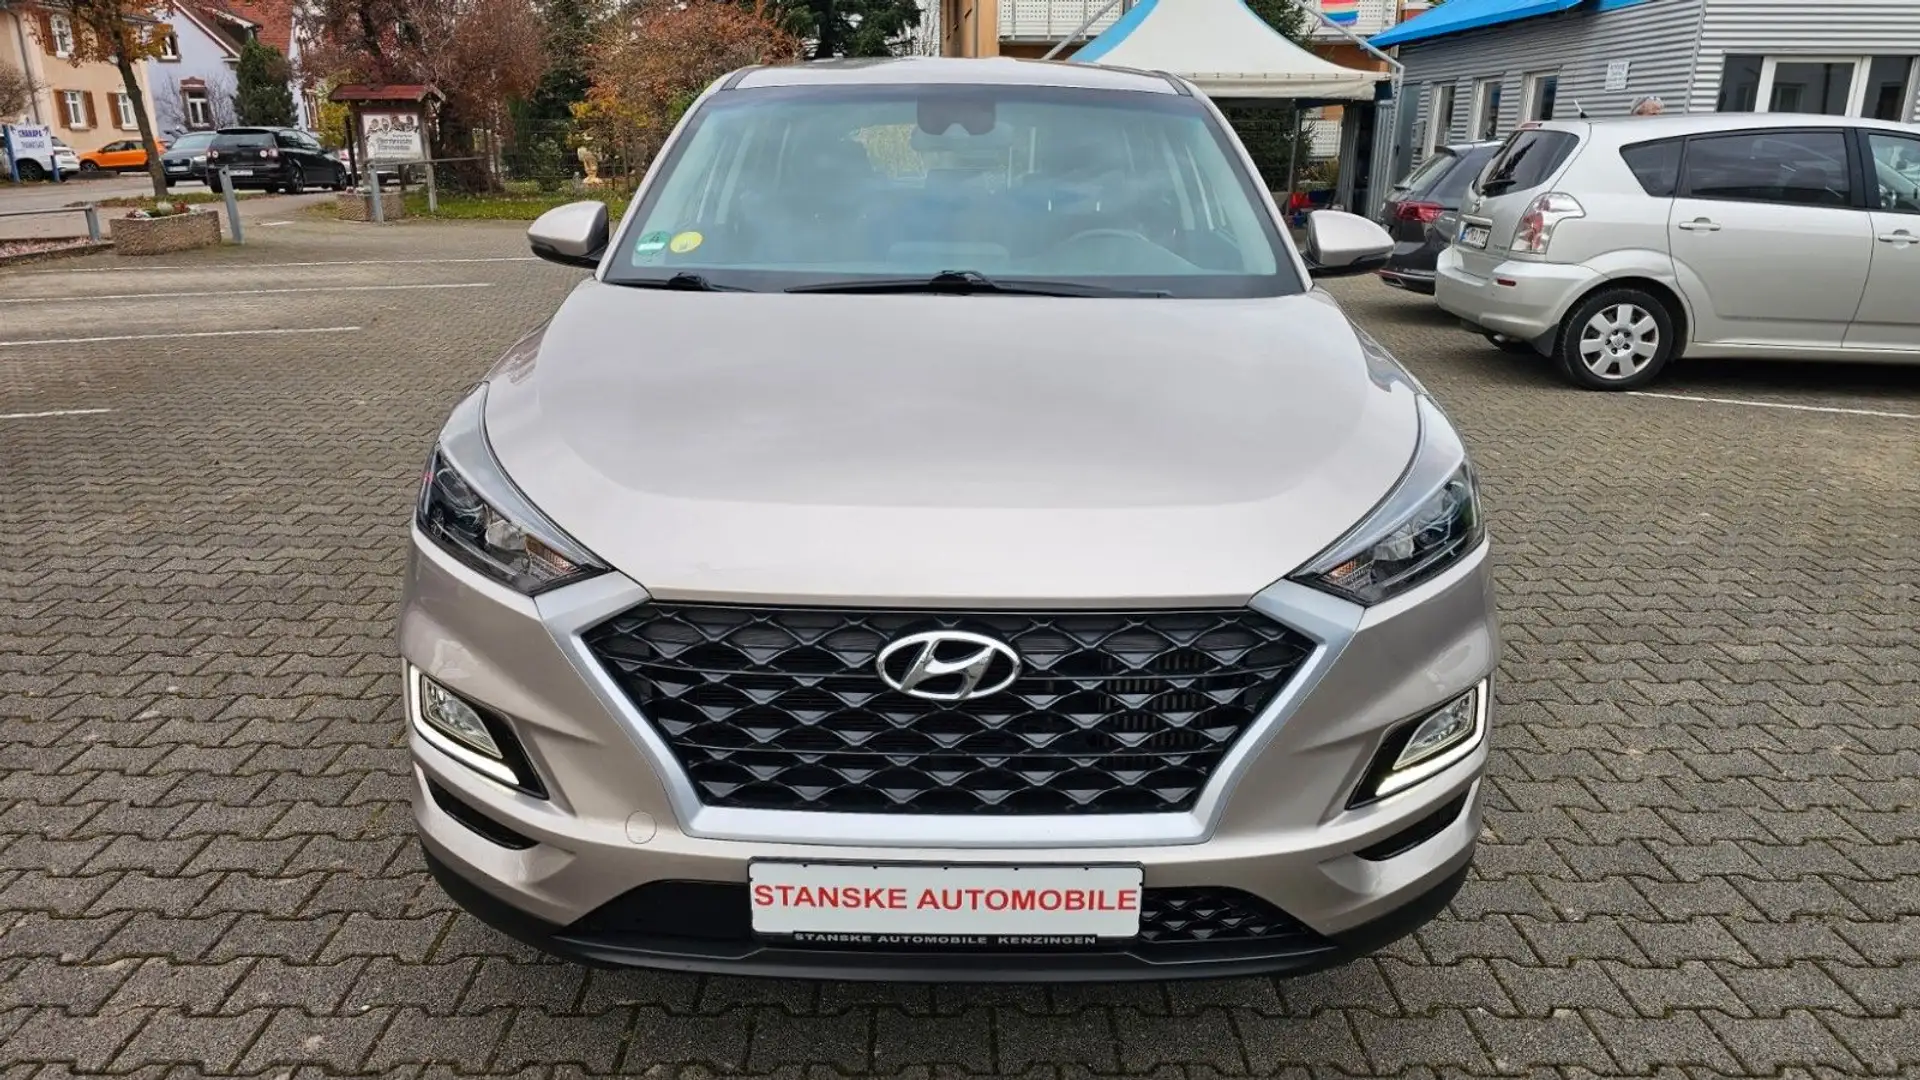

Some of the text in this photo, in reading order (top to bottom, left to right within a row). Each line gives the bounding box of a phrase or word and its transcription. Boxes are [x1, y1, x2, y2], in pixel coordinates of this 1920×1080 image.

[754, 885, 1138, 911] STANSKE AUTOMOBILE
[794, 933, 1096, 945] STANSKE AUTOMOBILE KENZINGEN
